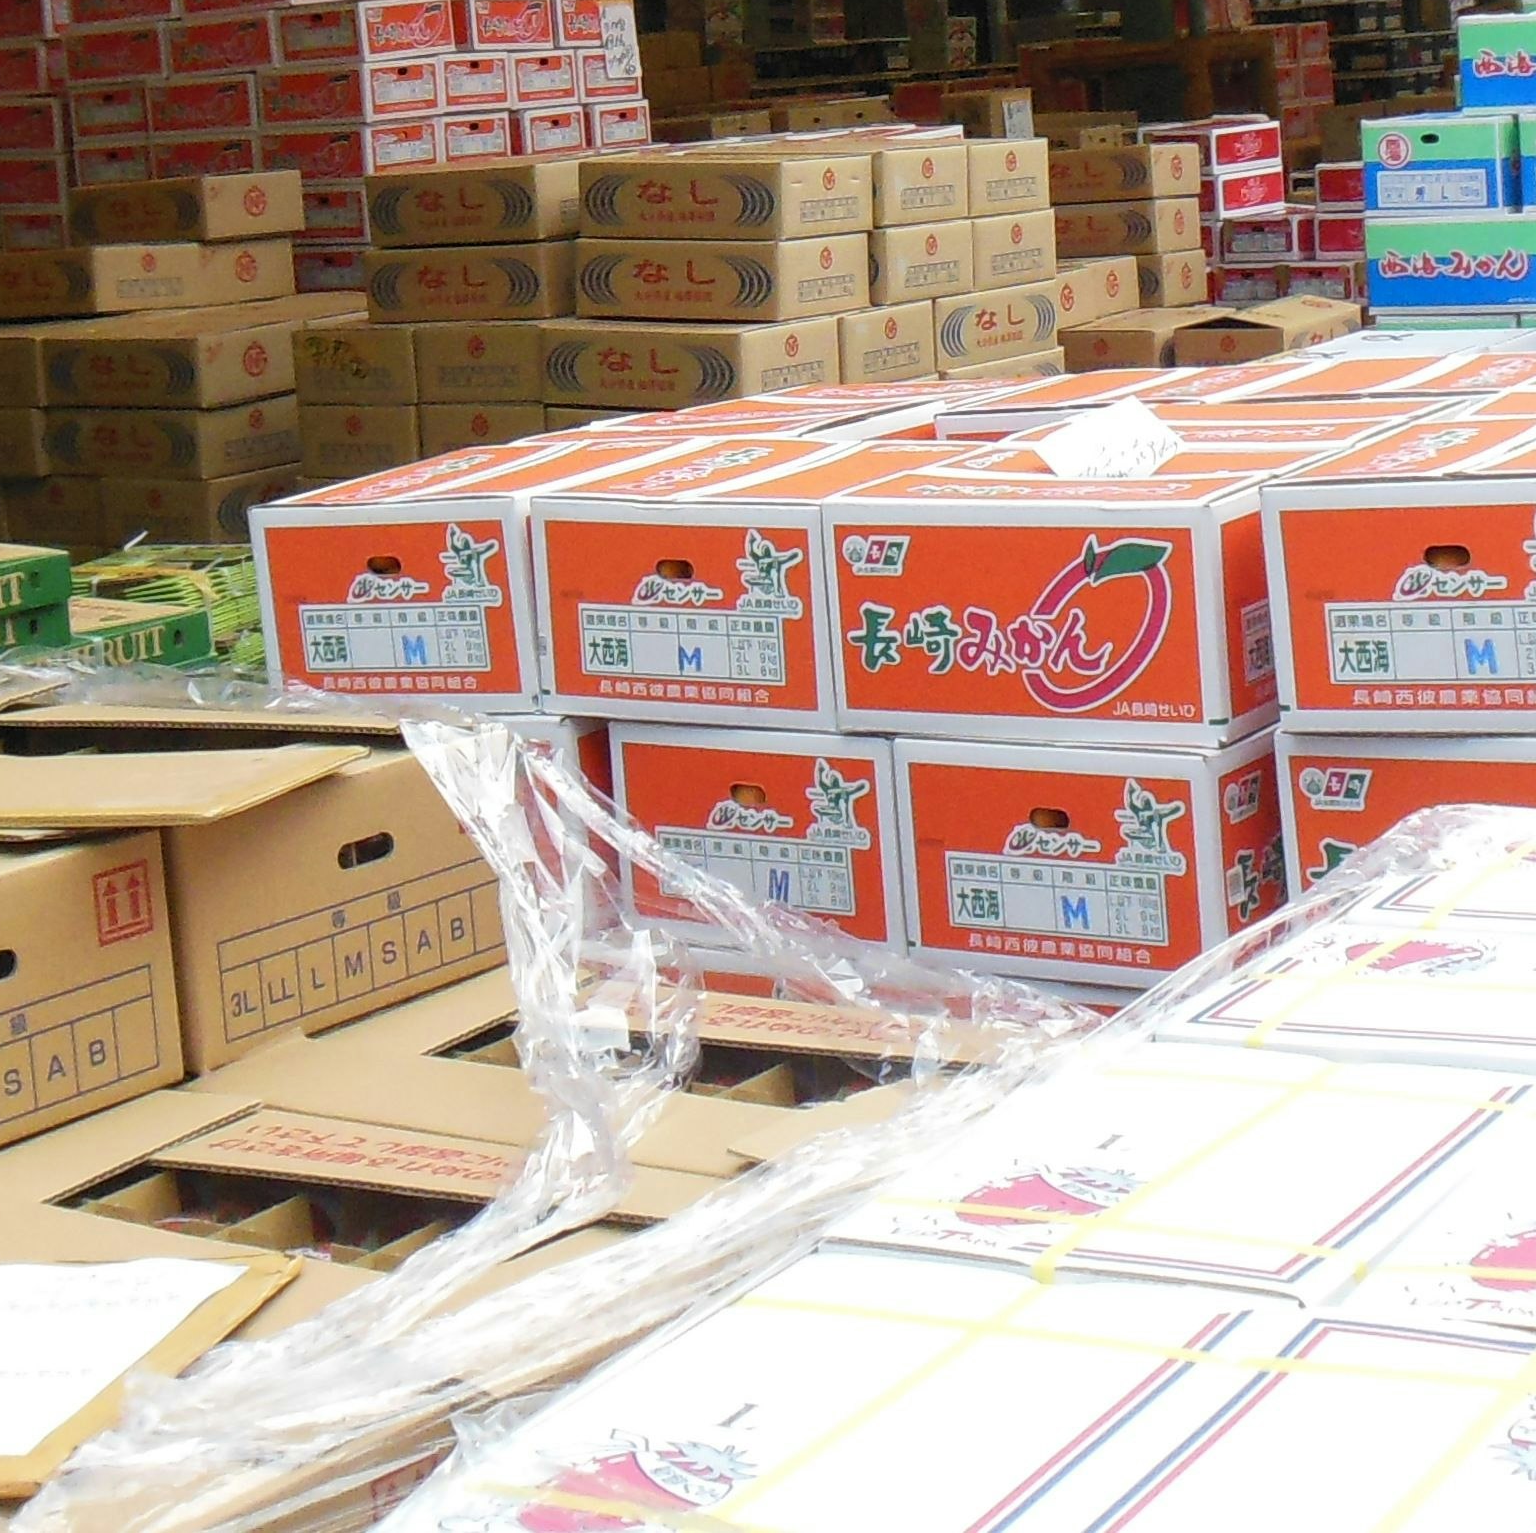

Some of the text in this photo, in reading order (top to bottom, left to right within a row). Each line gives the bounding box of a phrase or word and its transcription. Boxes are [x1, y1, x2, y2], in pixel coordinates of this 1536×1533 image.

[638, 179, 719, 205] なし
[633, 260, 715, 285] なし
[976, 304, 1025, 331] なし
[598, 348, 679, 374] なし
[310, 635, 428, 665] 大西海 M
[588, 637, 702, 672] 大西海 M
[849, 605, 1112, 674] 長崎みかん
[1338, 638, 1498, 675] 大西海 M
[769, 868, 789, 903] M
[957, 887, 1090, 930] 大西海 M
[231, 916, 465, 1016] 3L LL L M S A B
[3, 1068, 22, 1097] S
[46, 1055, 67, 1084] A
[89, 1038, 107, 1067] B
